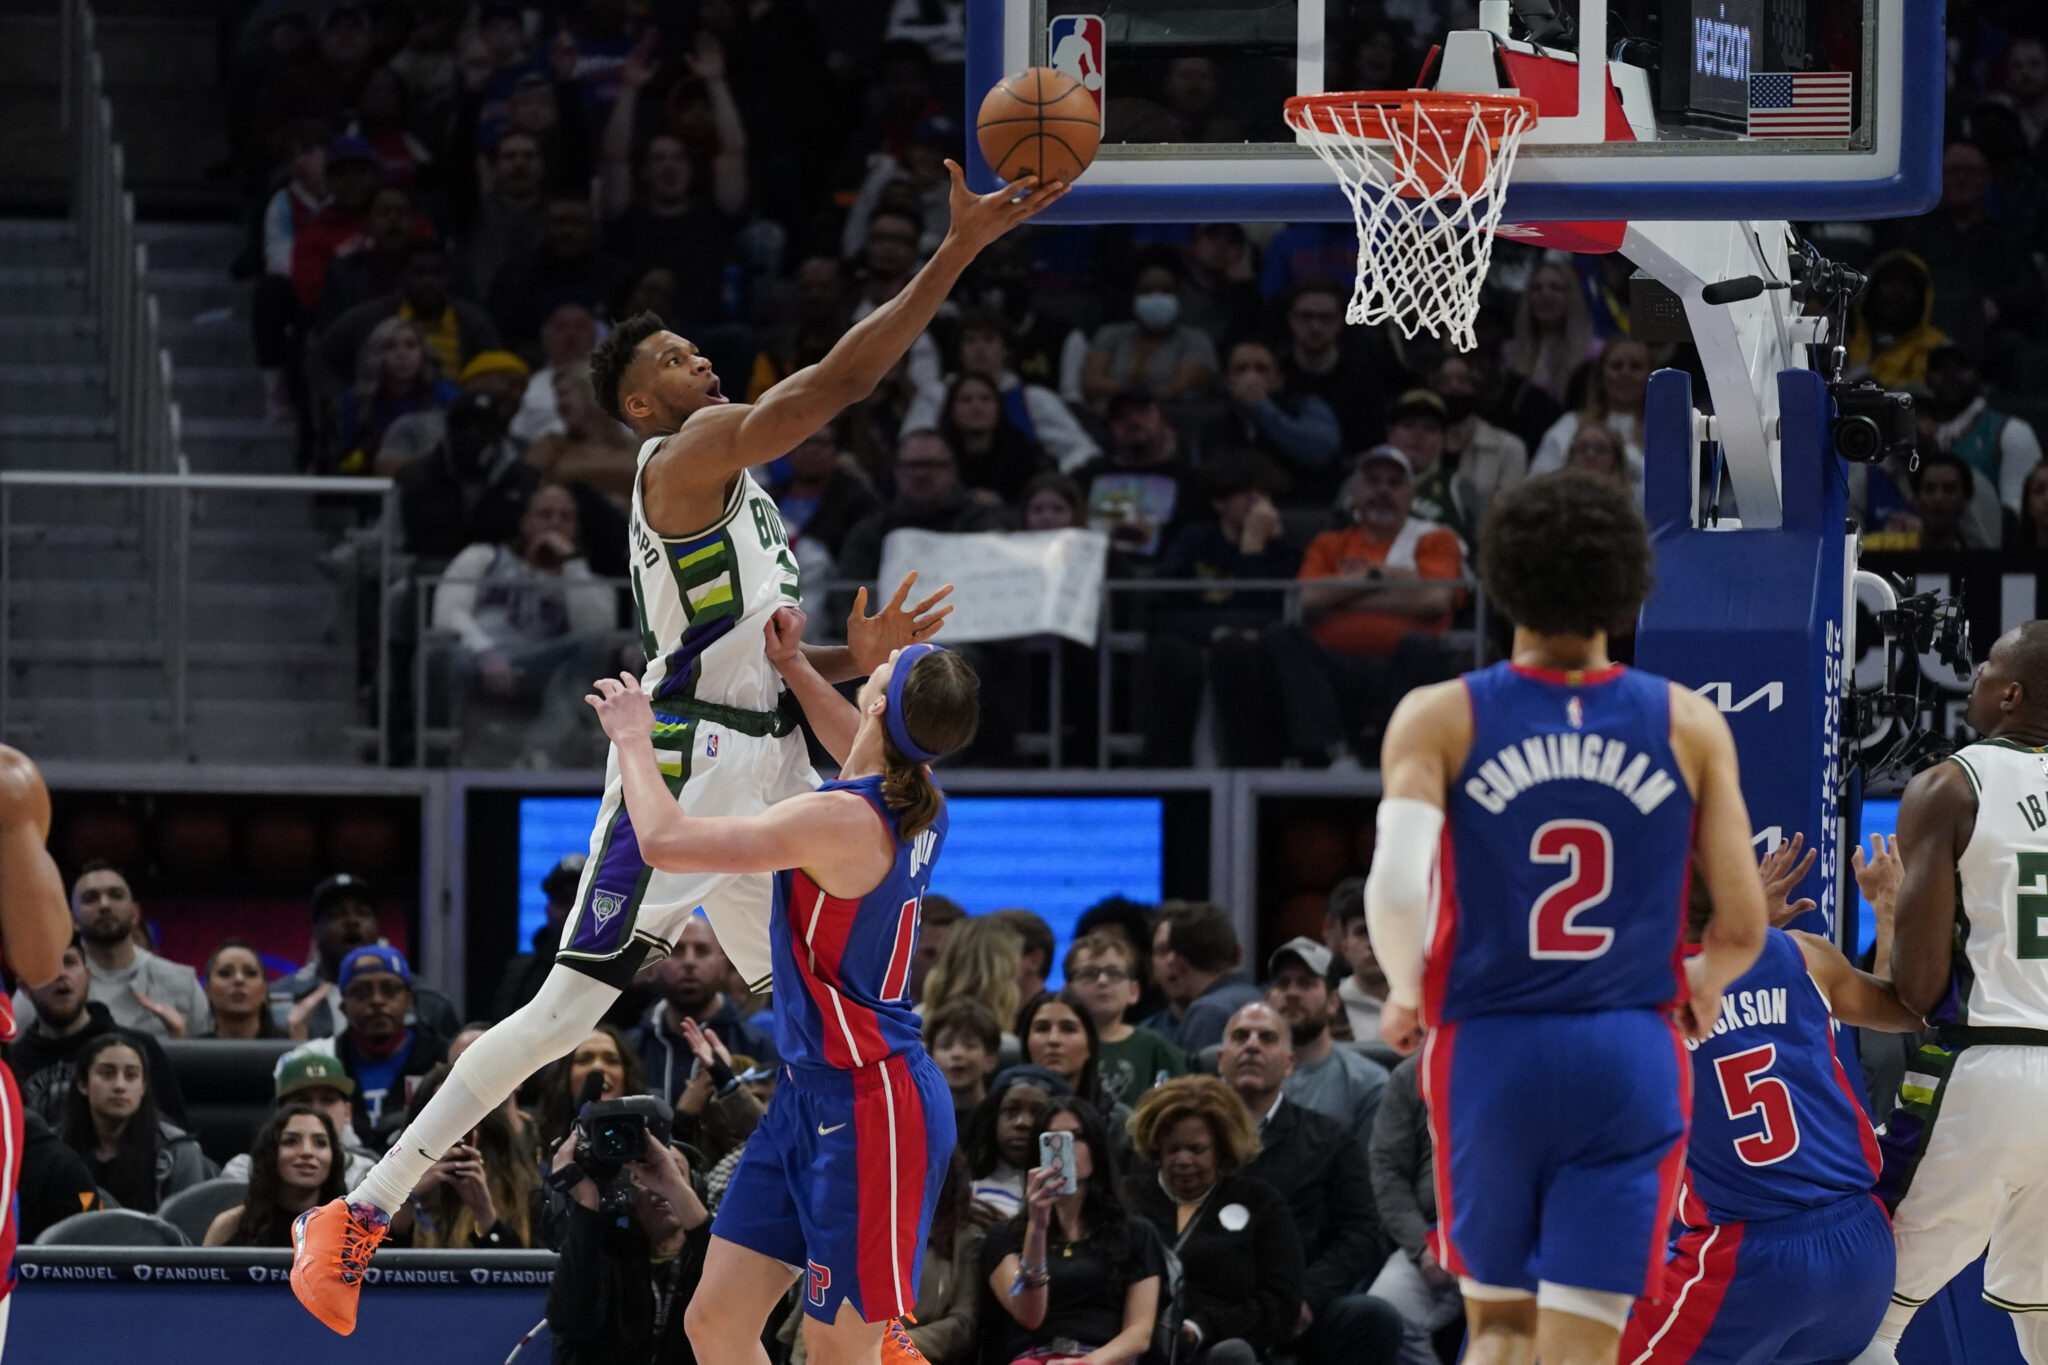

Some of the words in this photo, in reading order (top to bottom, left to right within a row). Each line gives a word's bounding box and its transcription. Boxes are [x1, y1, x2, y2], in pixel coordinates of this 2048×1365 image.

[1695, 3, 1750, 82] verizon
[1465, 733, 1677, 815] CUNNINGHAM
[1821, 619, 1834, 940] AFTKINGS
[2016, 791, 2048, 832] IB
[1529, 818, 1615, 960] 2
[1713, 1043, 1800, 1167] 5
[42, 1266, 117, 1279] FANDUEL
[155, 1267, 230, 1280] FANDUEL
[384, 1269, 460, 1283] FANDUEL
